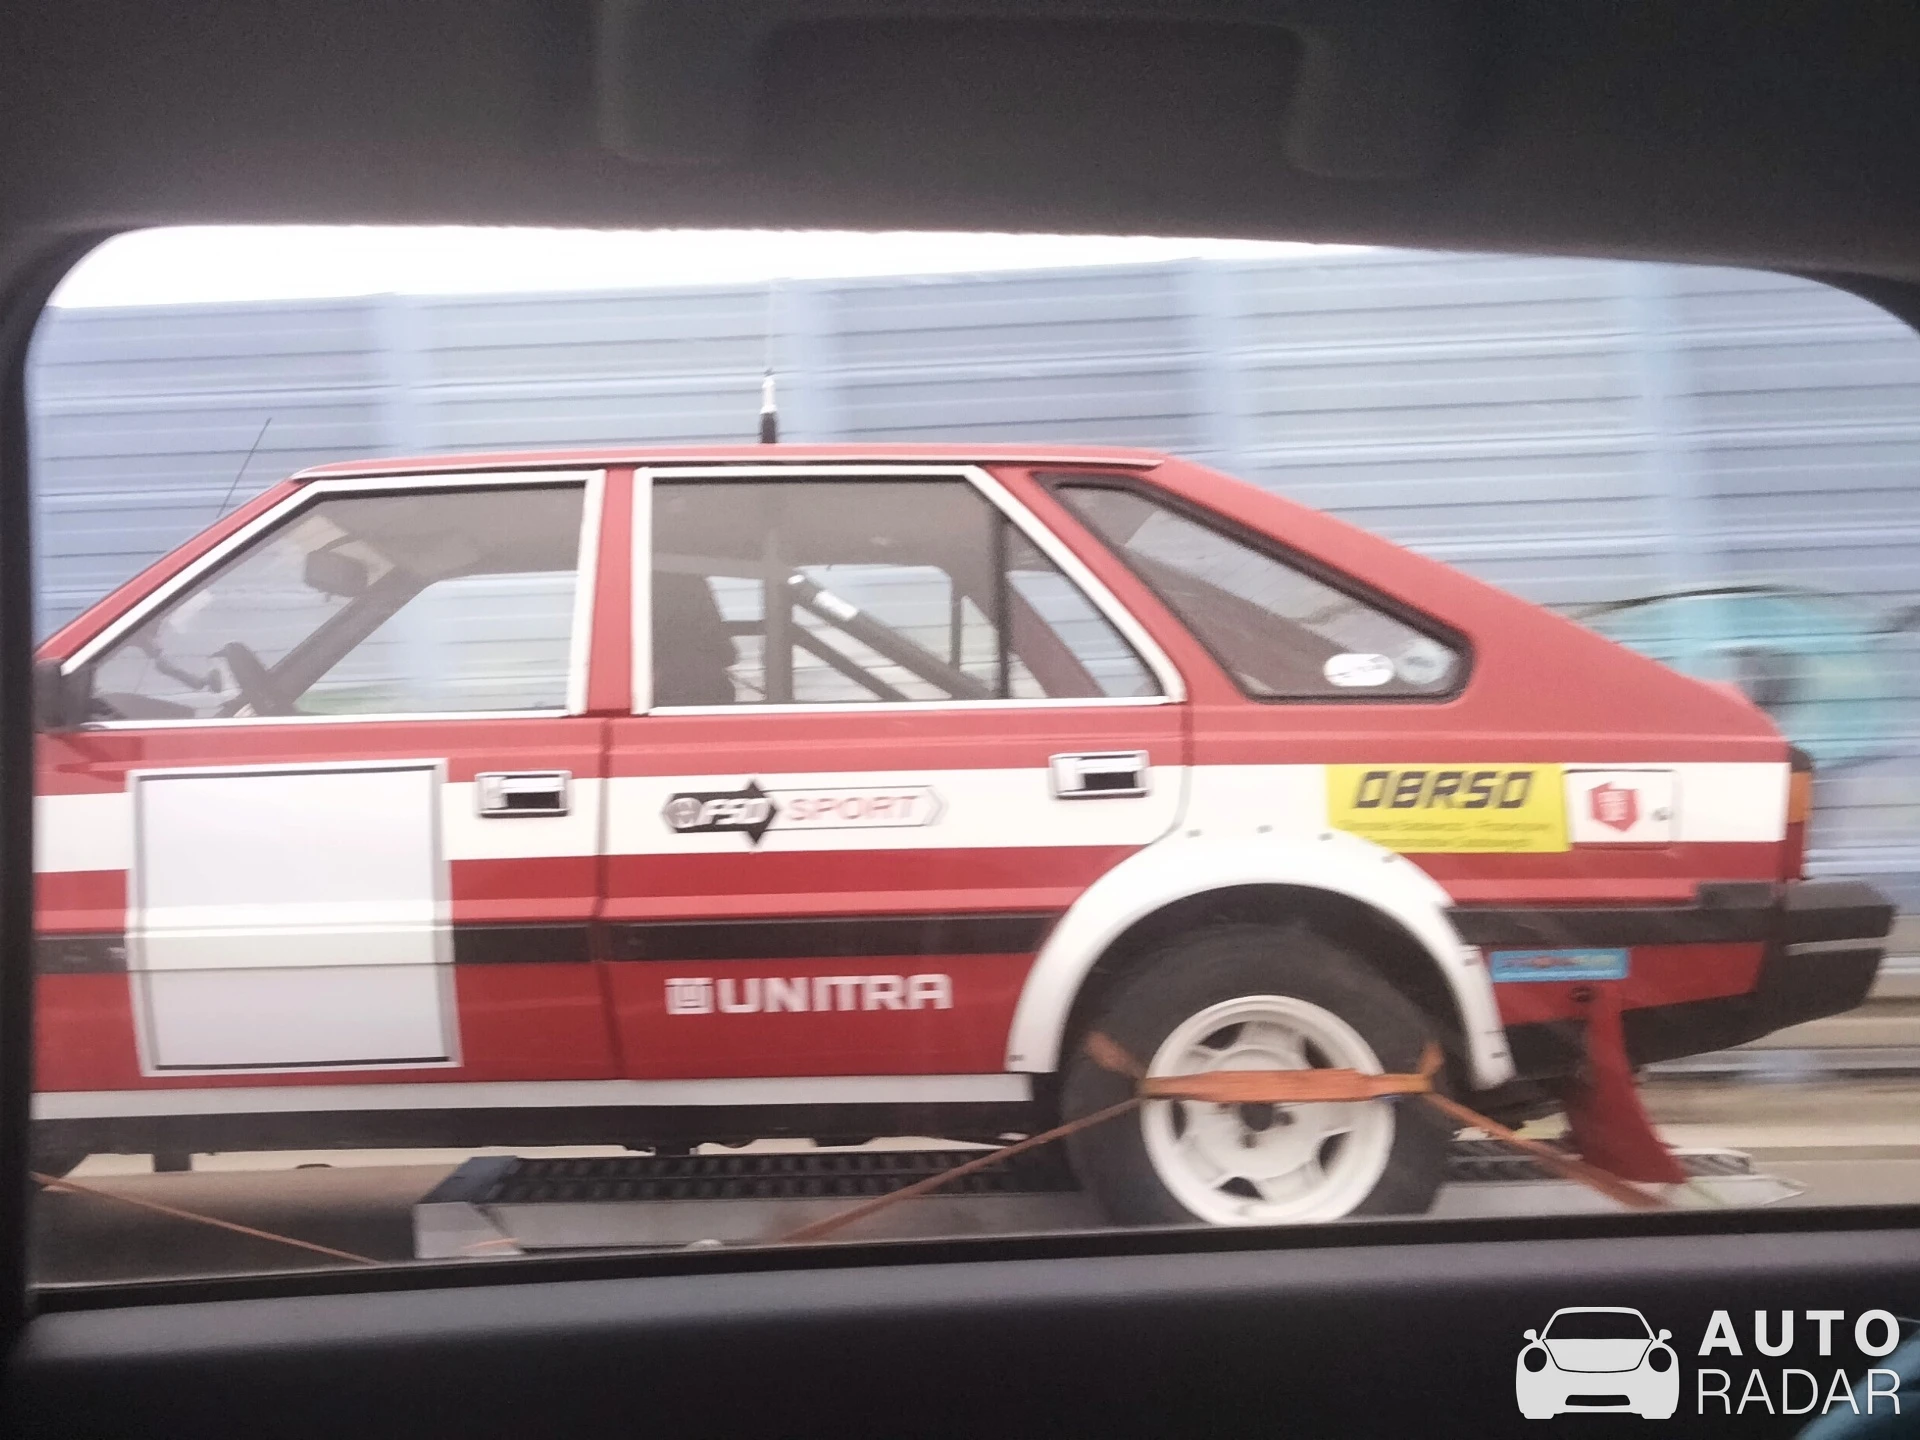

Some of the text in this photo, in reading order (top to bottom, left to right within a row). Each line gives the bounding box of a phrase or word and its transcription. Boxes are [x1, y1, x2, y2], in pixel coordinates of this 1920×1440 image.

[788, 796, 919, 821] SPORT
[1352, 770, 1535, 809] OBRSO
[716, 974, 954, 1014] UNITRA
